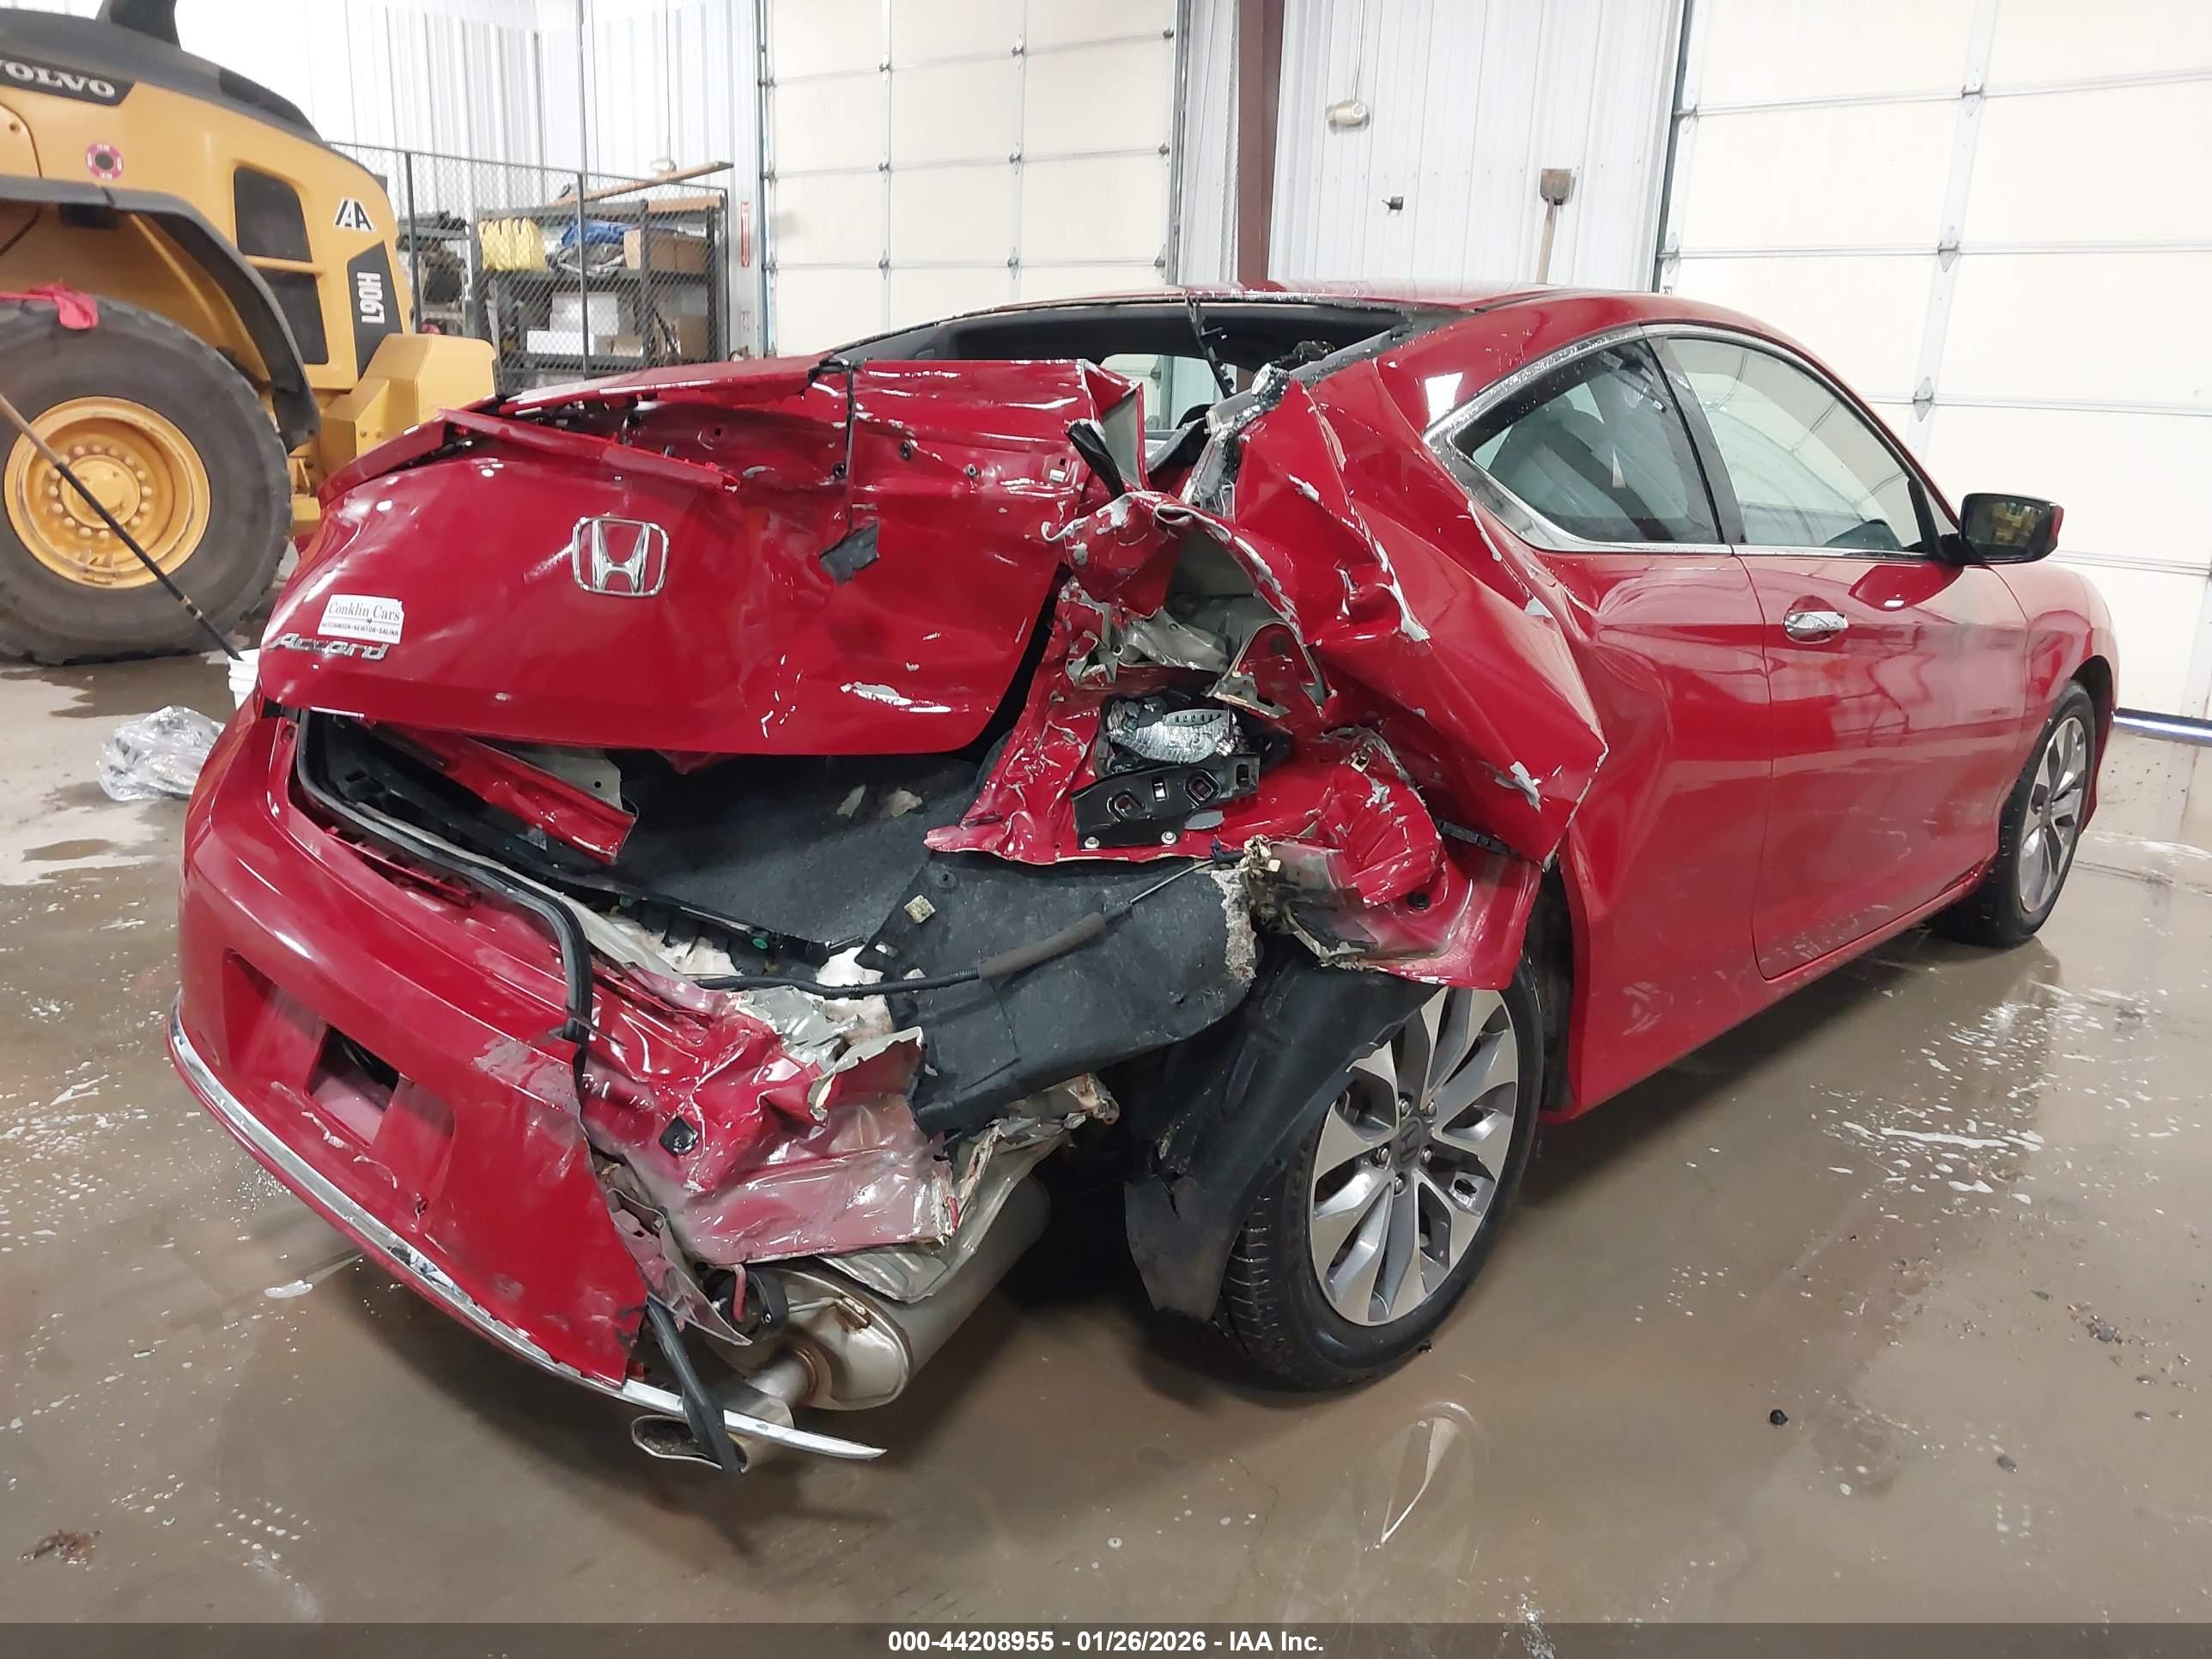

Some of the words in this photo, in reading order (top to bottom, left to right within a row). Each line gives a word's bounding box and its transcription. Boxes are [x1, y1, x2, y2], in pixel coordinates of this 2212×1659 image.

[0, 59, 116, 97] OLVO
[356, 272, 386, 324] L90H
[328, 602, 370, 617] Conklin
[373, 605, 401, 622] Cars
[268, 633, 389, 660] Accord
